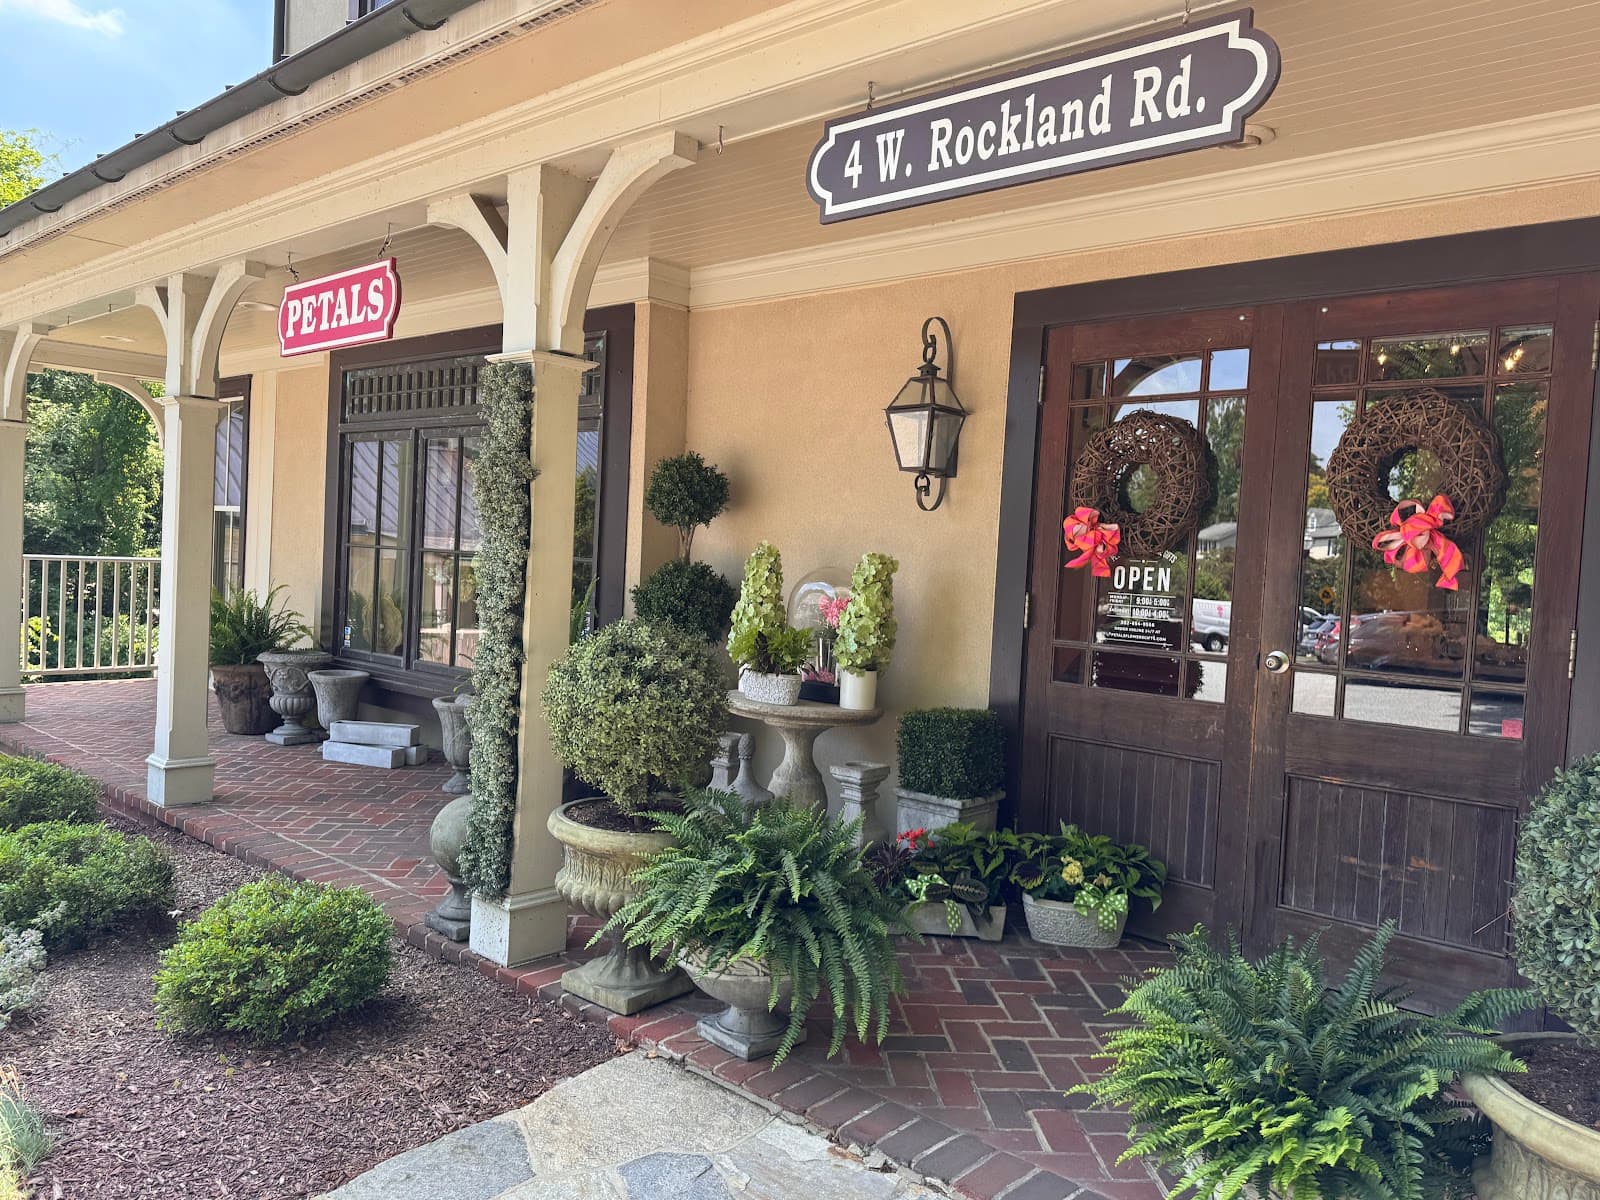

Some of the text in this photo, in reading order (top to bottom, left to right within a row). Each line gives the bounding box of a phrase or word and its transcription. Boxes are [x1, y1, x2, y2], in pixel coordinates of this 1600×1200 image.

[843, 53, 1206, 190] 4 W. Rockland Rd.
[285, 277, 385, 338] PETALS
[1113, 565, 1171, 593] OPEN
